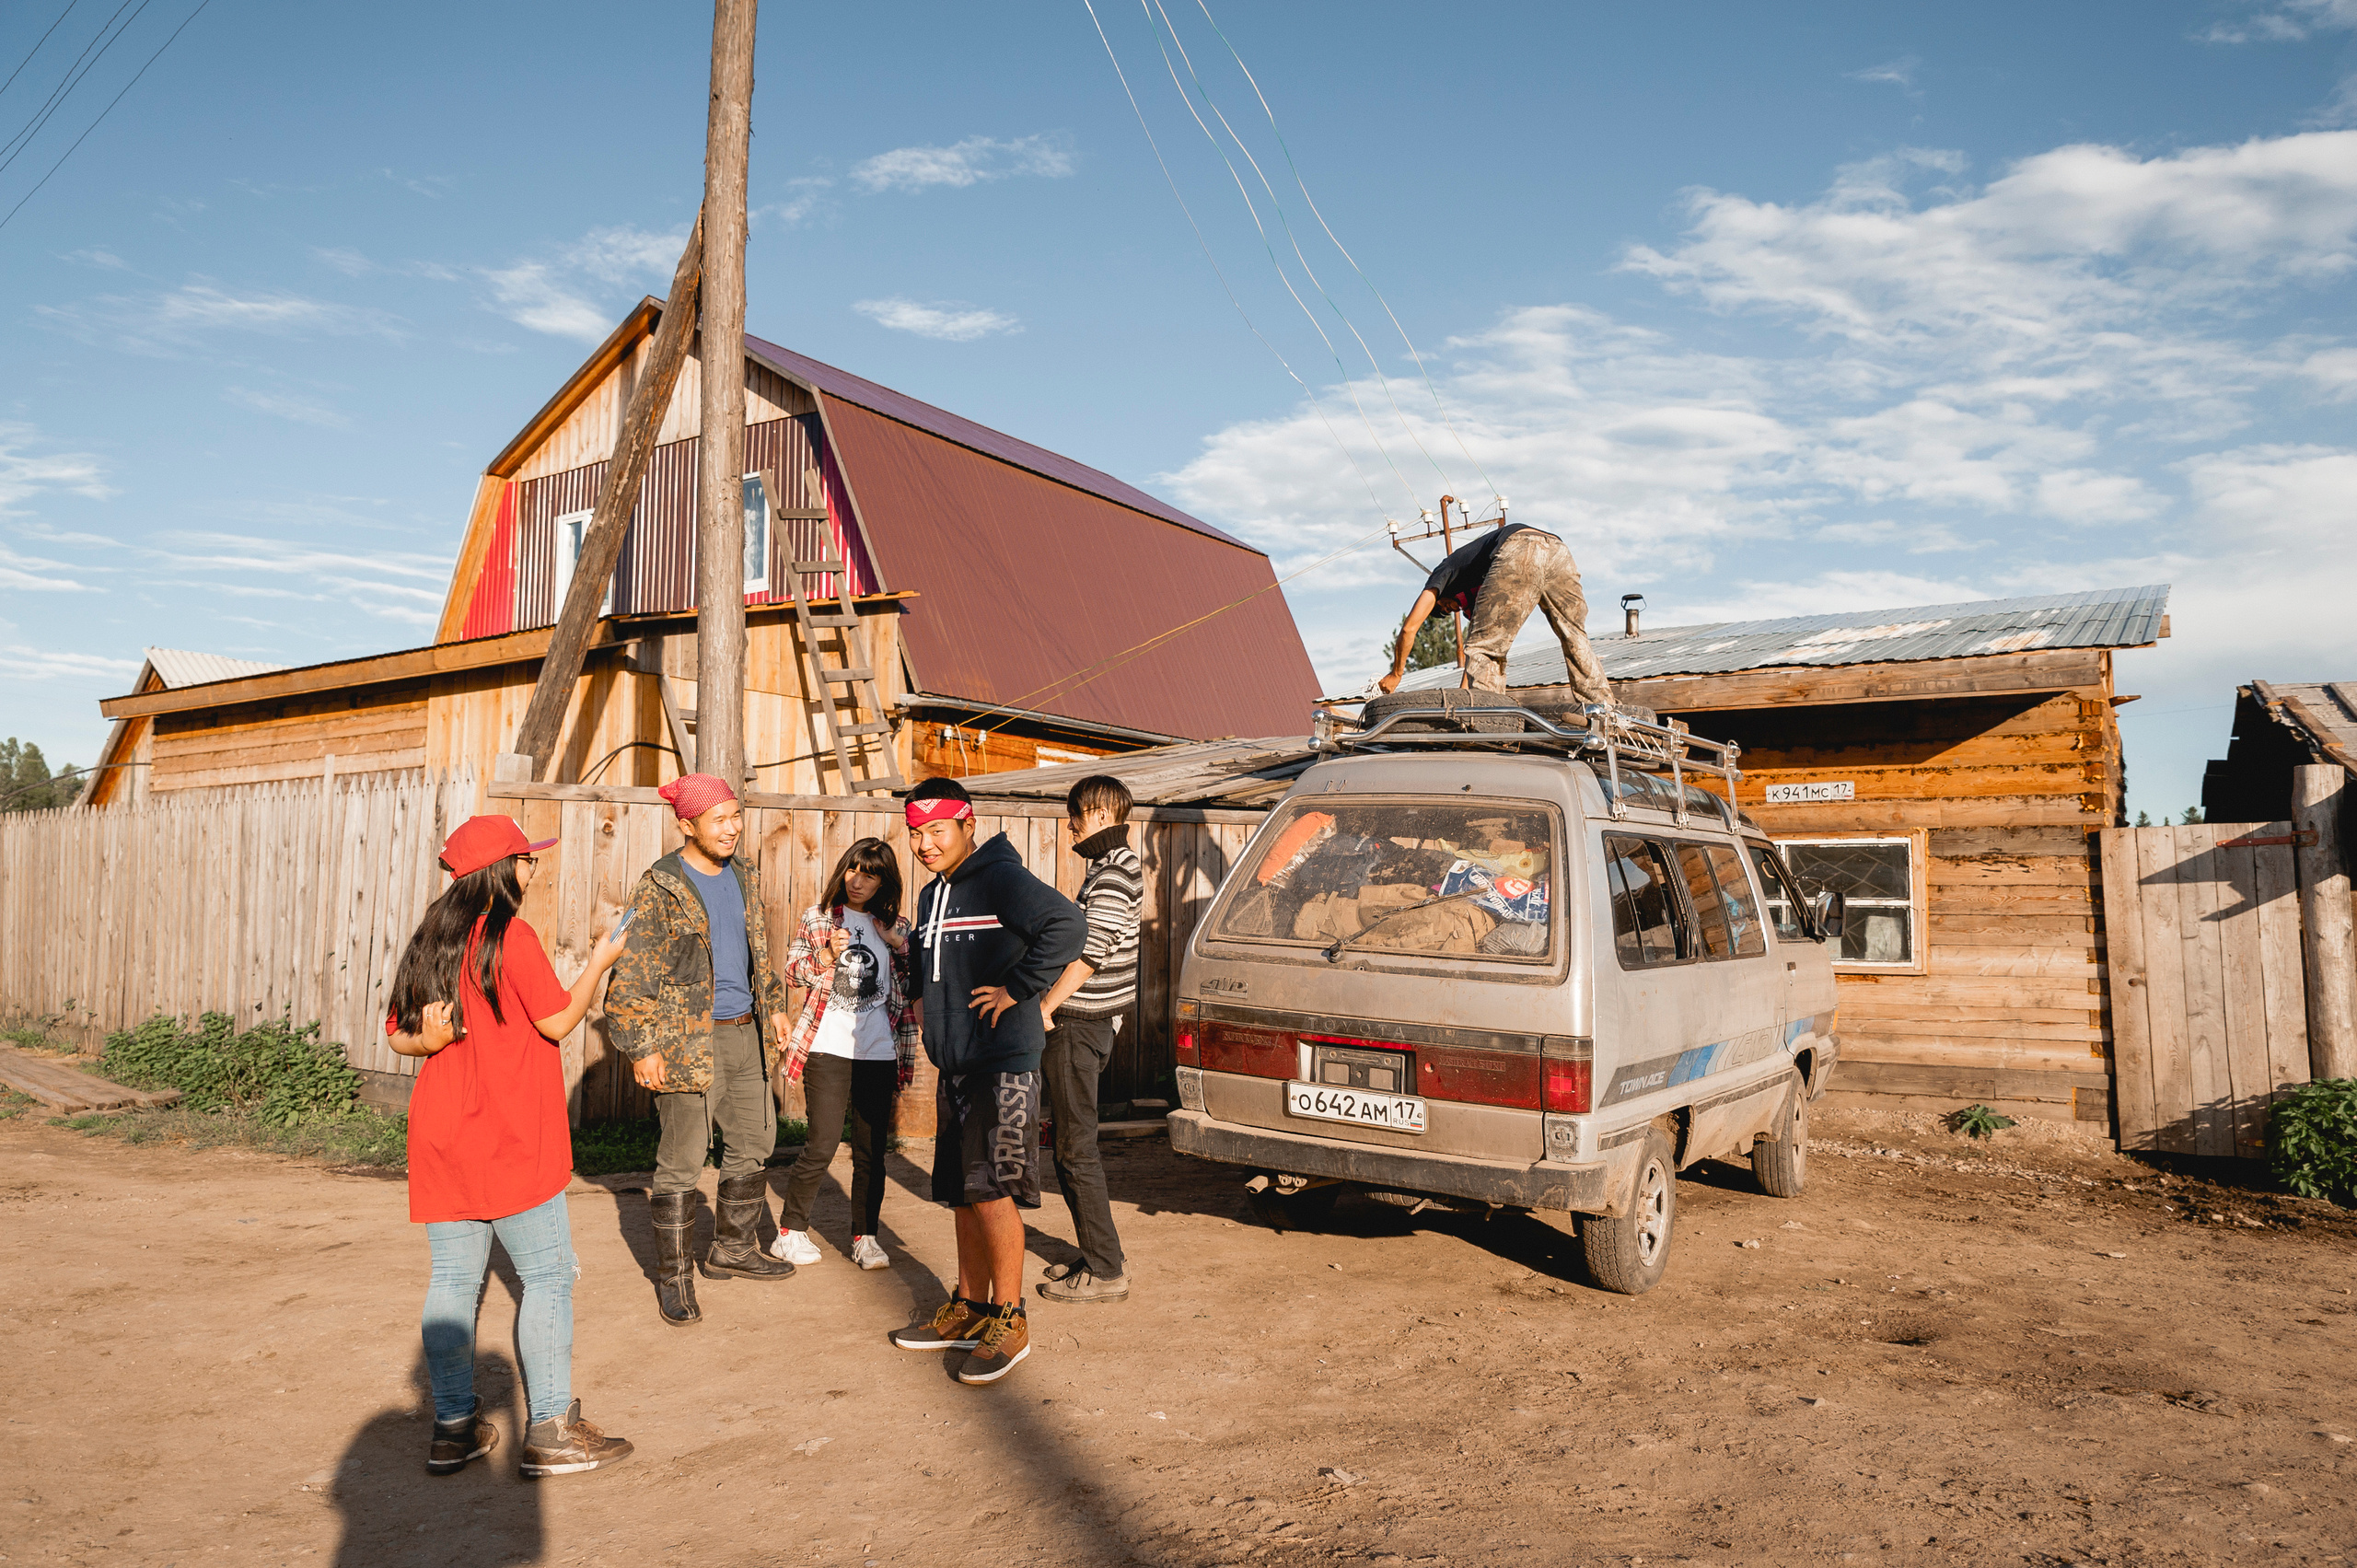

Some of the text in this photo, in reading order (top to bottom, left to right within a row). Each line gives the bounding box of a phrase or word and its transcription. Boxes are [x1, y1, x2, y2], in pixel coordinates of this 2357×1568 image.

[1306, 1016, 1407, 1040] TOYOTA
[1394, 1100, 1416, 1120] 17
[1392, 1118, 1410, 1126] RUS
